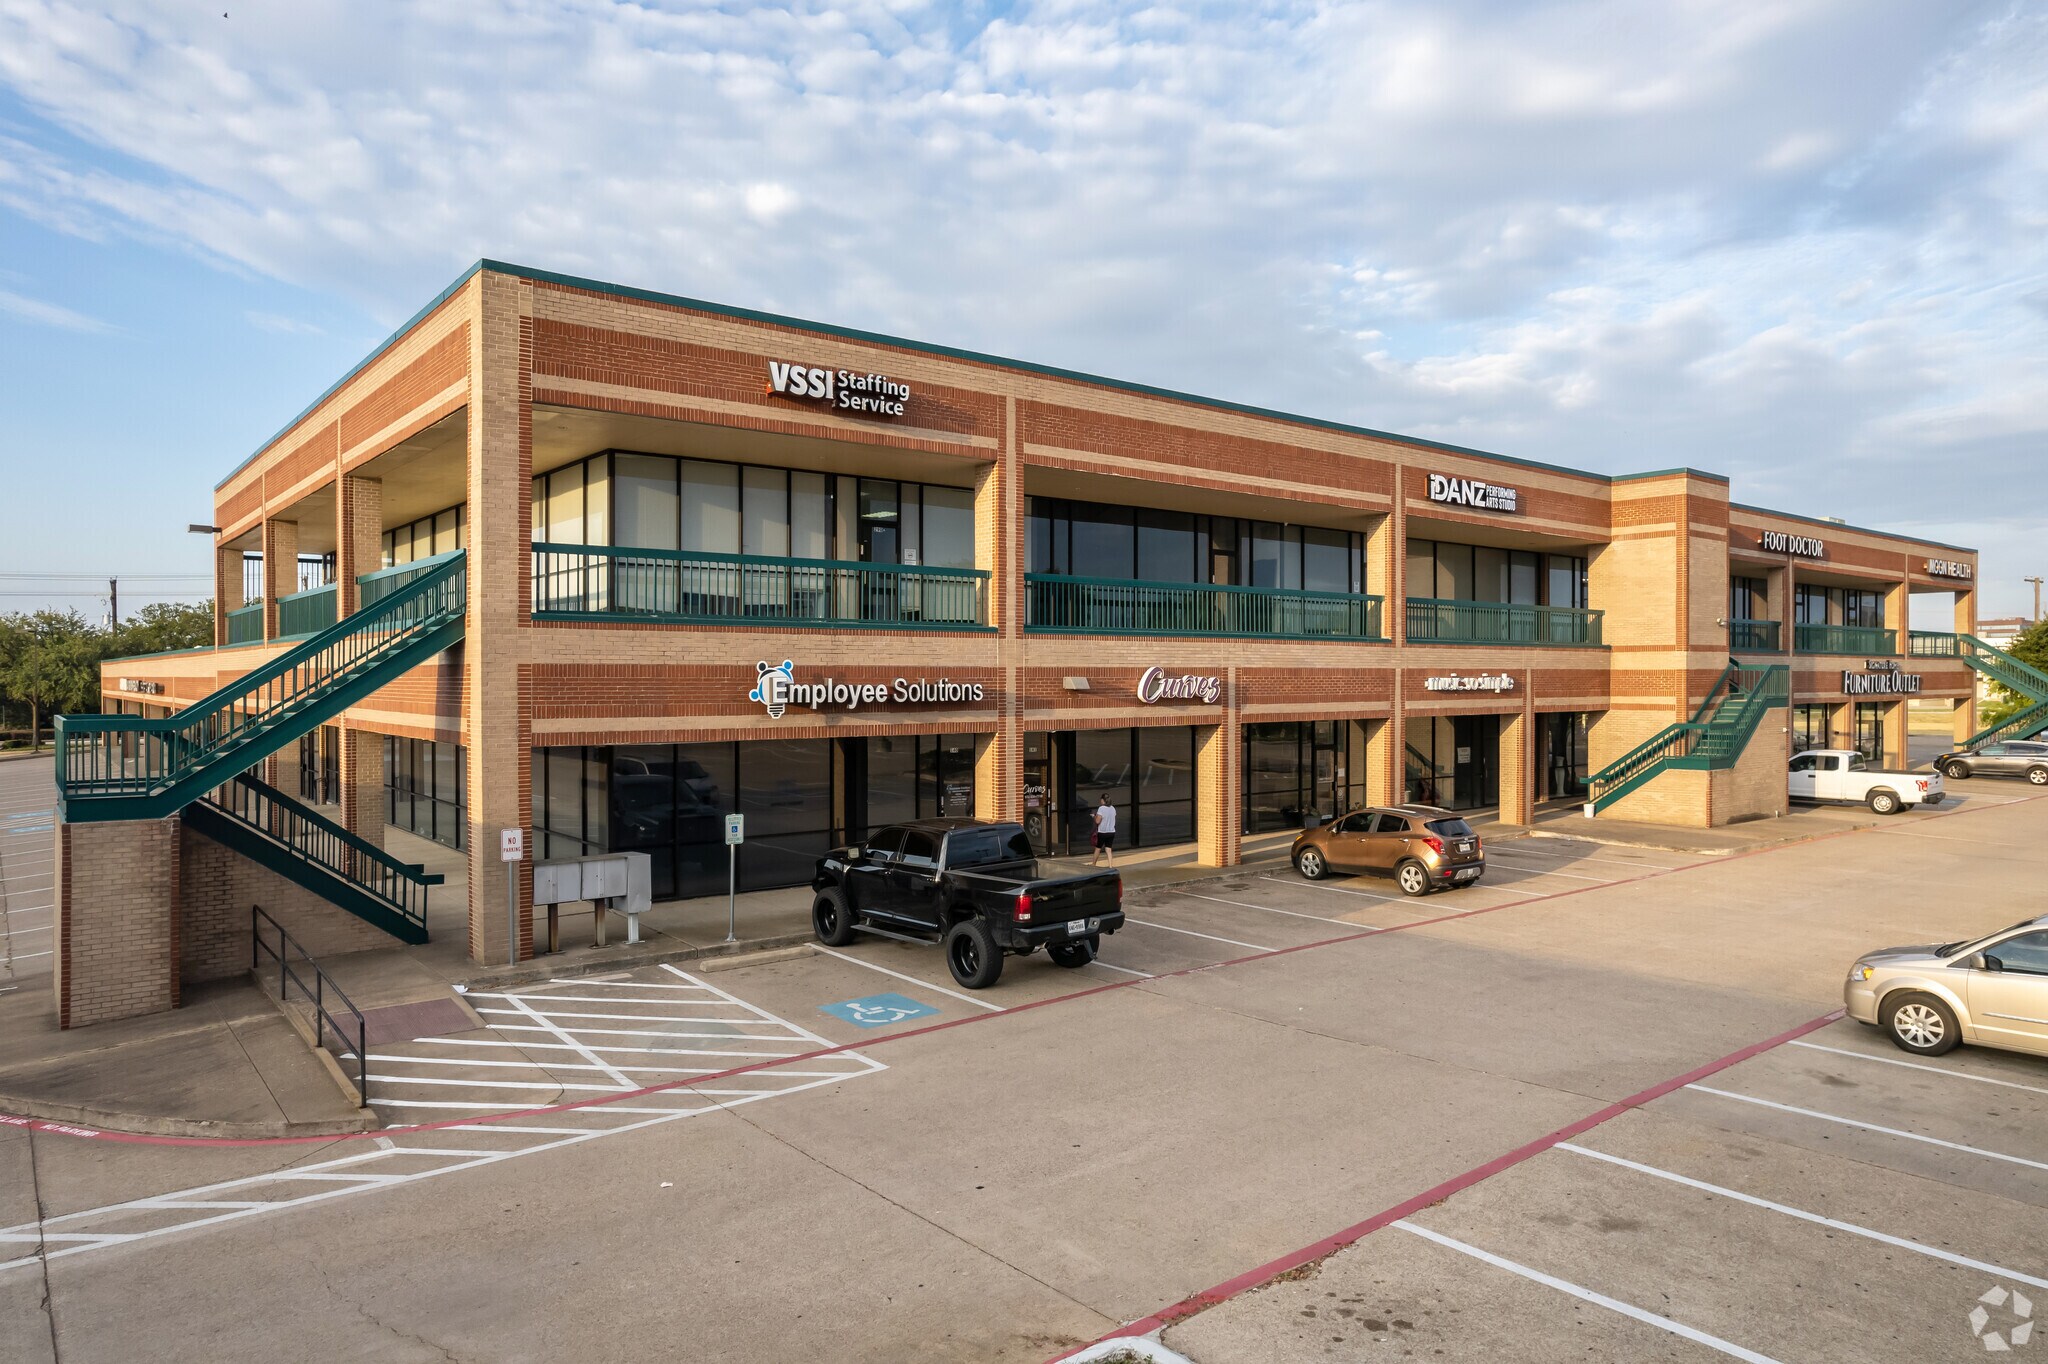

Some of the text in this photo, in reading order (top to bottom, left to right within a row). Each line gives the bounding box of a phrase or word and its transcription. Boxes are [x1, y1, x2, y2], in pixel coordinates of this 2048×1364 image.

[769, 361, 834, 399] VSSI
[837, 370, 910, 401] Staffing
[839, 390, 904, 416] Service
[1486, 485, 1516, 500] PERFORMING
[1486, 496, 1516, 511] ARTS STUDIO
[1764, 531, 1824, 557] FOOT DOCTOR
[1947, 560, 1972, 578] HEALTH
[769, 677, 984, 709] Employee Solutions
[1137, 666, 1221, 704] Curves
[1844, 670, 1920, 694] FURNITURE OUTLET
[507, 836, 517, 845] NO
